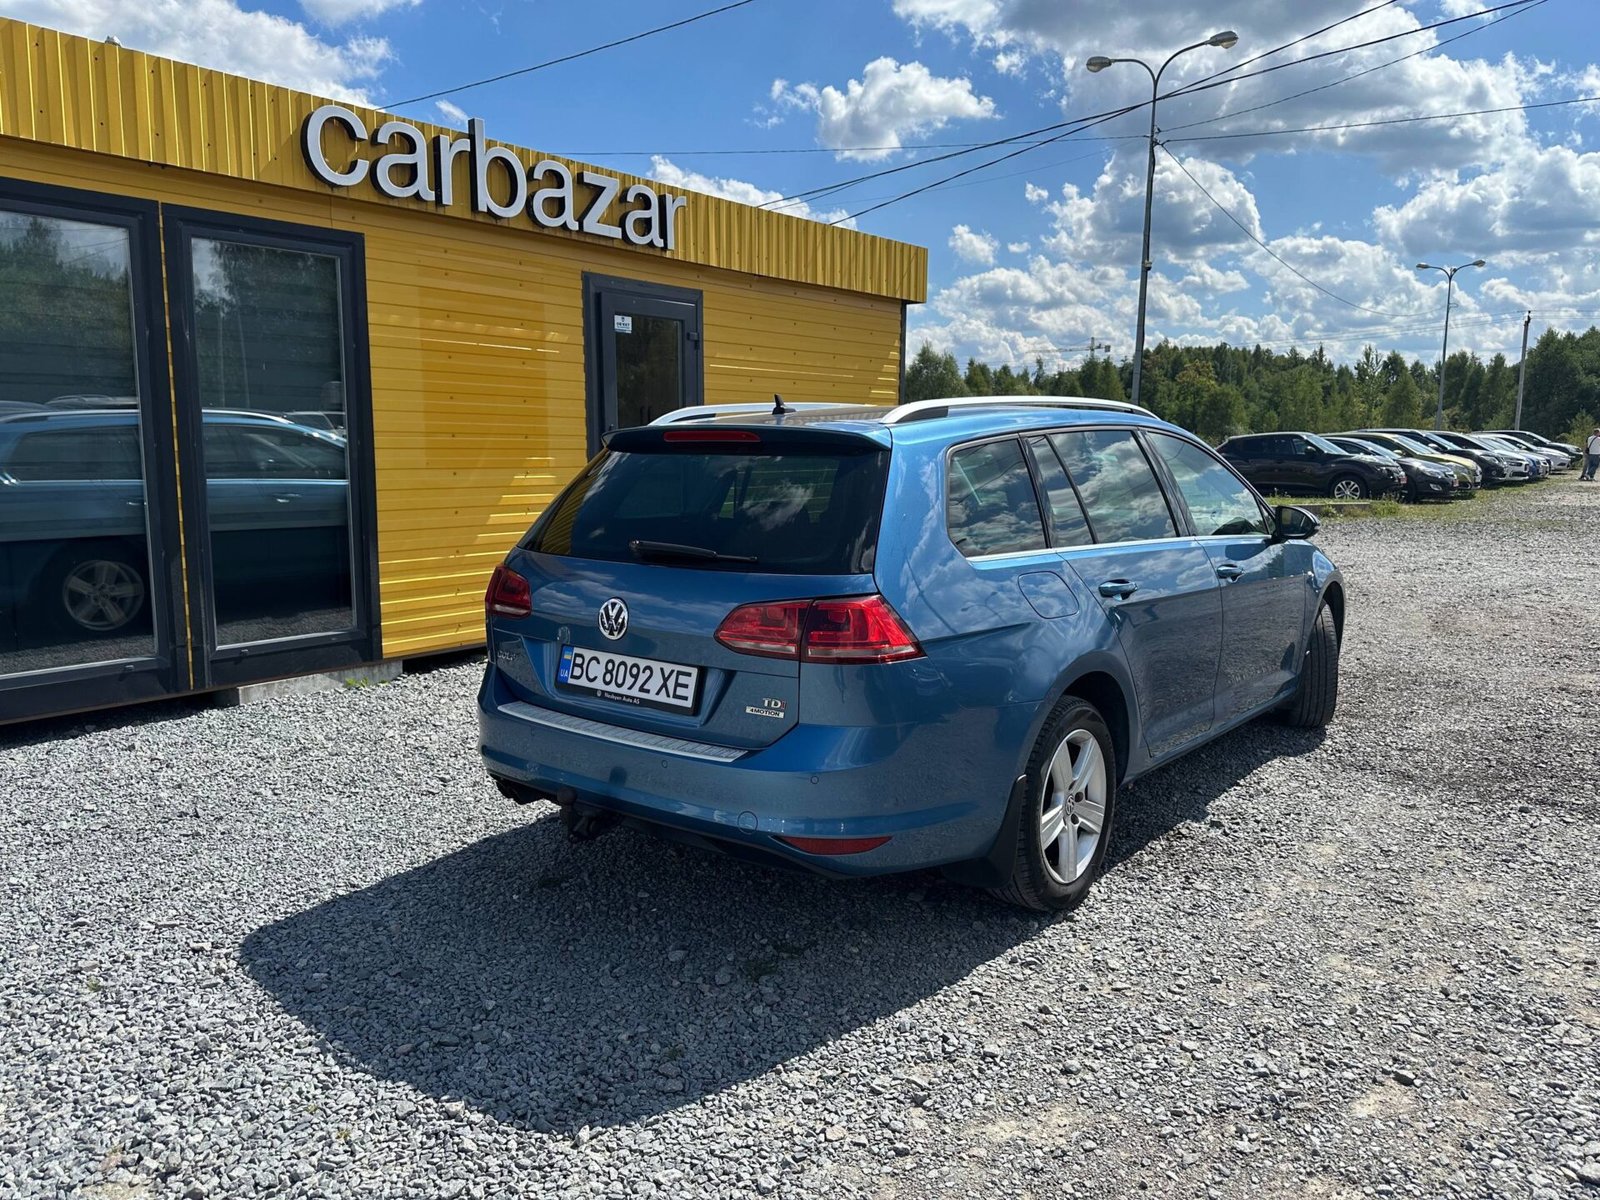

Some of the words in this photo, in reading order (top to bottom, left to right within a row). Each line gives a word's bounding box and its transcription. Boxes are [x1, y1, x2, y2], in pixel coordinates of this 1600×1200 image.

[301, 104, 687, 251] carbazar
[560, 668, 569, 678] UA
[570, 652, 601, 683] BC
[602, 658, 654, 694] 8092
[655, 667, 692, 701] XE
[763, 697, 786, 710] TDI
[750, 707, 780, 717] 4MOTION
